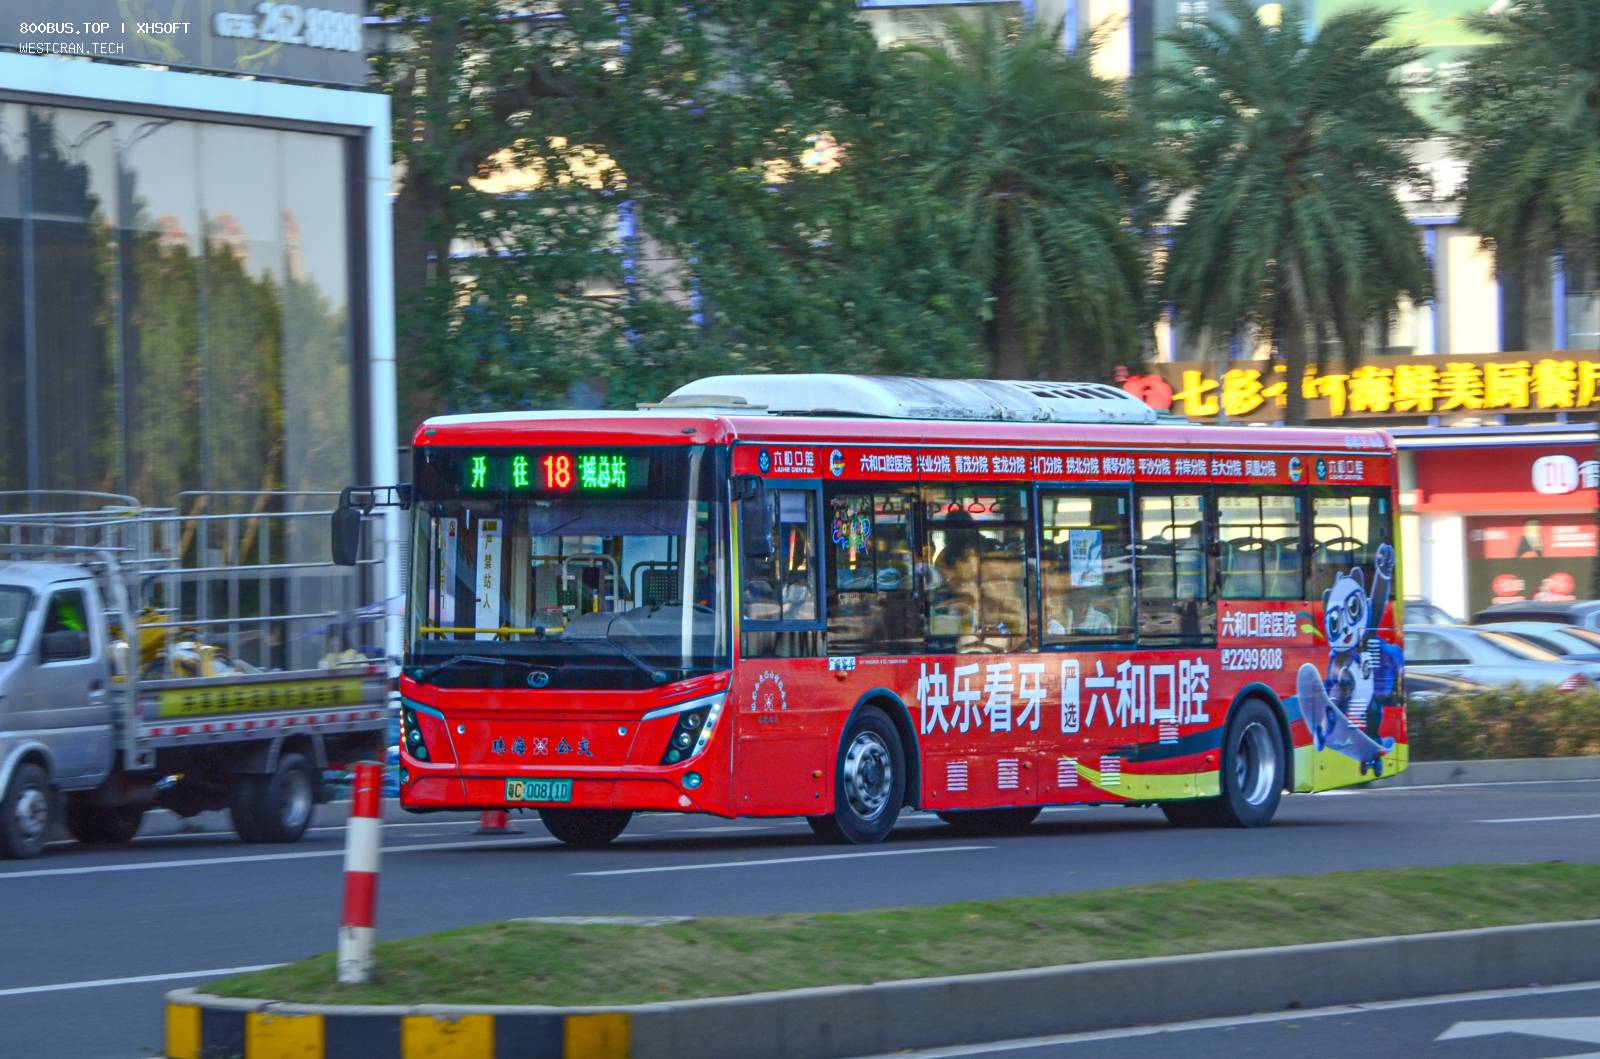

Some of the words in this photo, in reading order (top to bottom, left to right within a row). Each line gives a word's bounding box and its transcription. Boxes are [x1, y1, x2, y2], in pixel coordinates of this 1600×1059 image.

[544, 456, 570, 488] 18
[860, 454, 912, 473] 六和口腔医院
[916, 454, 951, 473] 兴业分院
[992, 455, 1026, 473] 宝龙分院
[1138, 458, 1171, 475] 平沙分院
[1211, 459, 1242, 476] 吉大分院
[1221, 611, 1297, 638] 六和口腔医院
[917, 663, 1048, 735] 快乐看牙
[1085, 658, 1210, 729] 六和口腔
